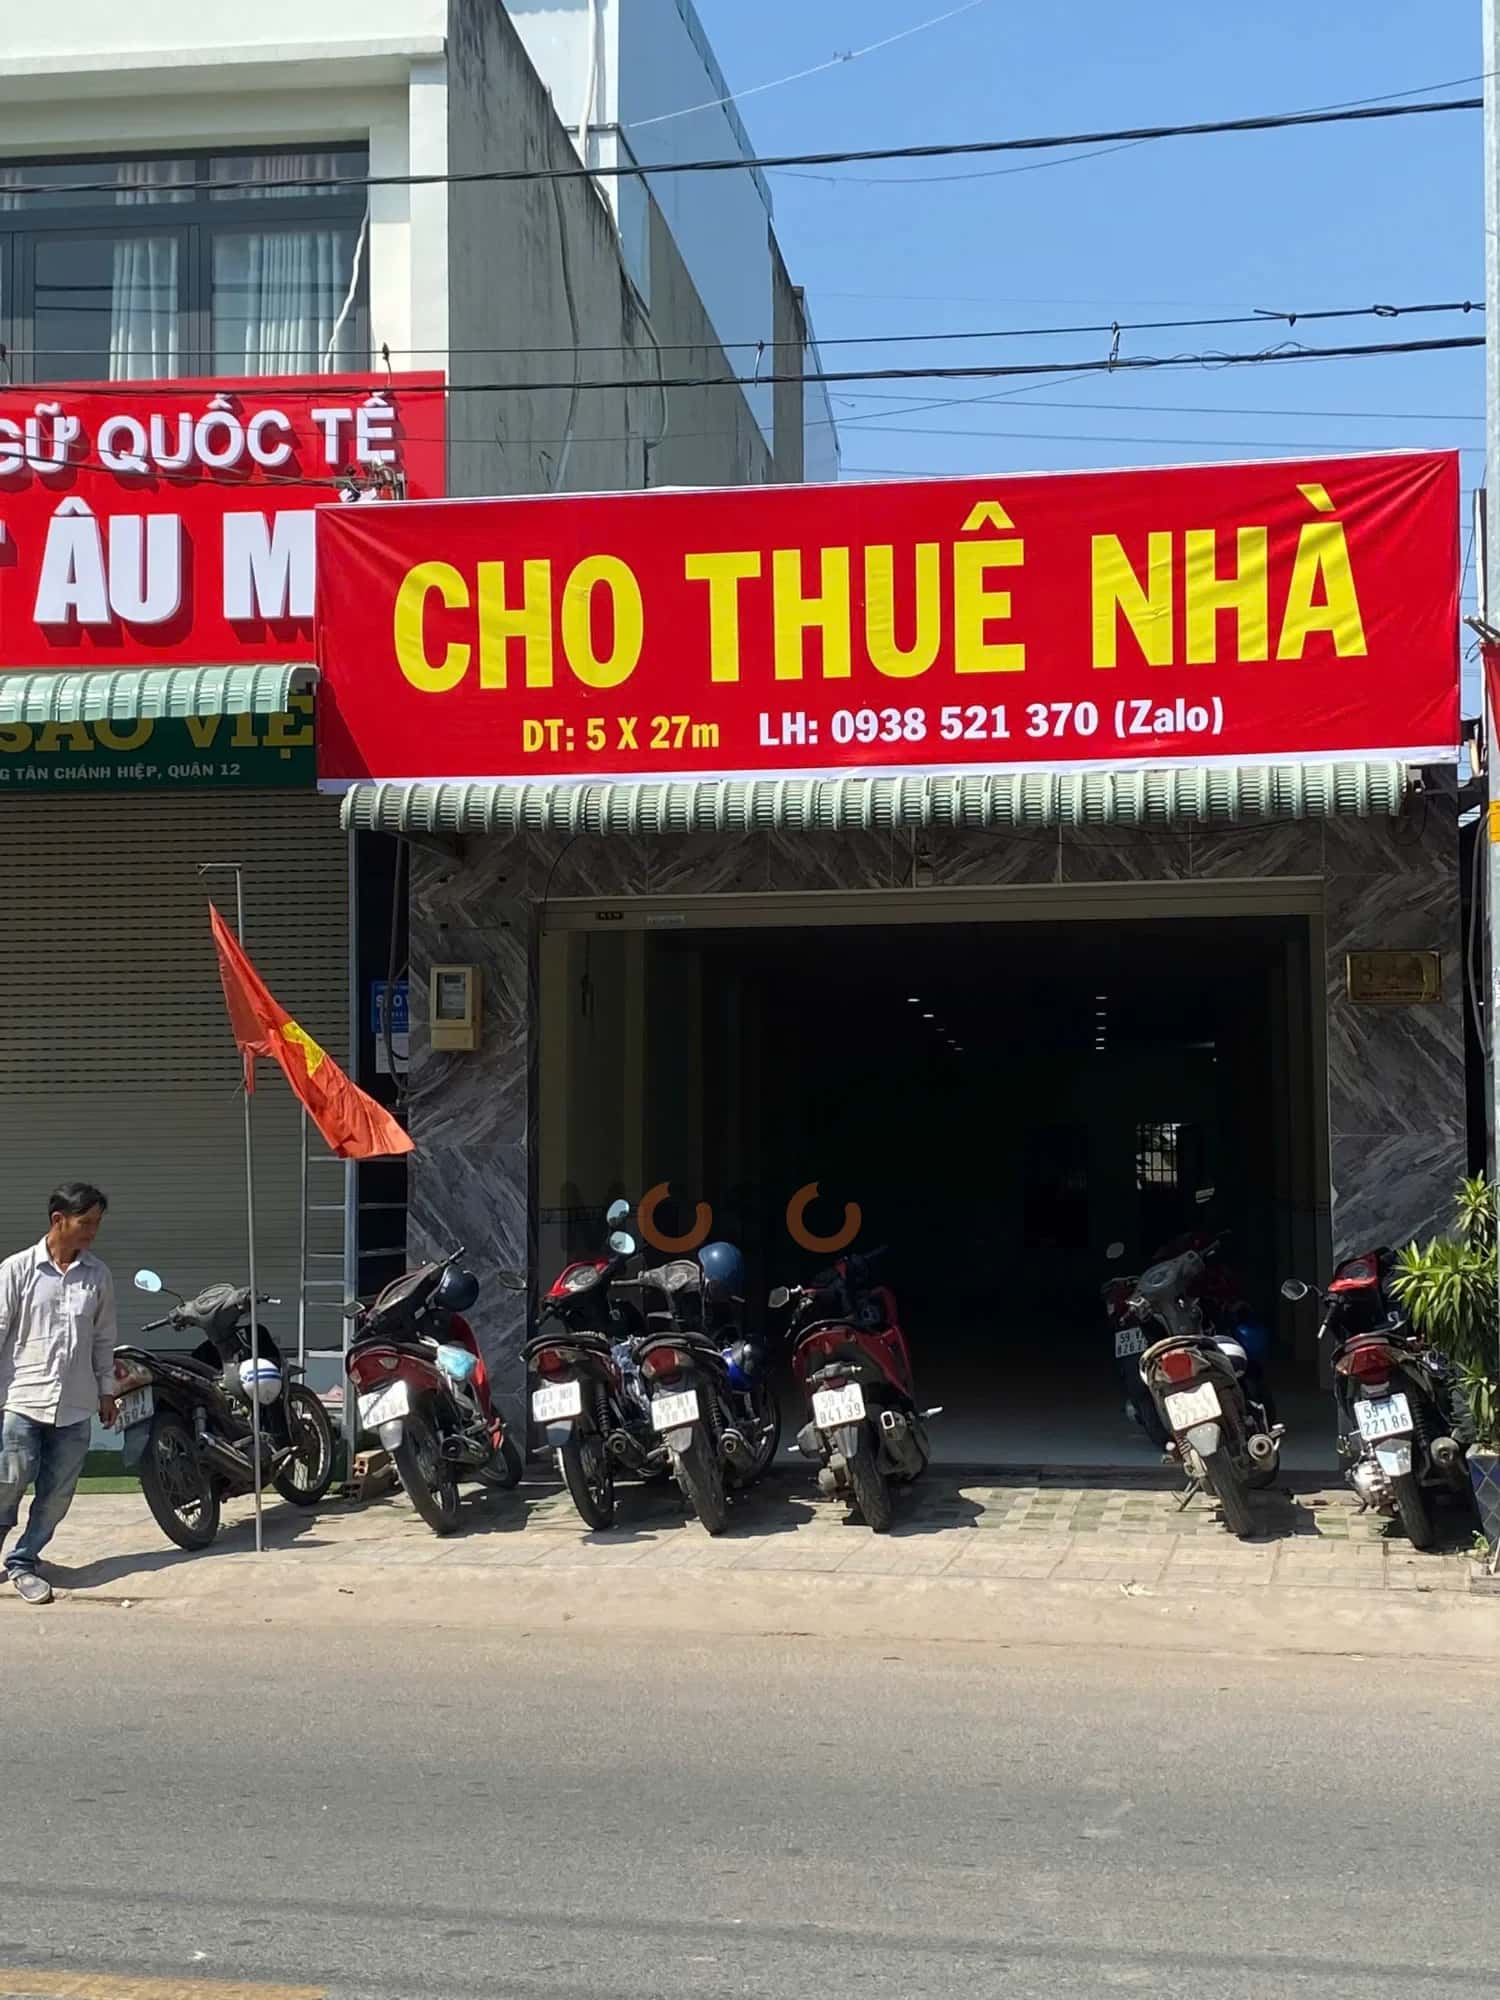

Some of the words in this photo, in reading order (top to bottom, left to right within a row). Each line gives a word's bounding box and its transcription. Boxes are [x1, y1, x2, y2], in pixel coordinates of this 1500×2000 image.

[98, 392, 292, 472] QUỐC
[311, 391, 396, 465] TẾ
[33, 496, 181, 623] ÂU
[394, 554, 644, 693] CHO
[685, 502, 1026, 683] THUÊ
[1092, 484, 1368, 669] NHÀ
[523, 719, 574, 752] DT:
[586, 718, 606, 750] 5
[617, 717, 639, 749] X
[650, 715, 719, 748] 27m
[759, 712, 818, 746] LH:
[831, 707, 927, 743] 0938
[940, 705, 1010, 740] 521
[1026, 702, 1098, 737] 370
[1115, 697, 1224, 738] (Zalo)
[15, 765, 49, 780] TÂN
[54, 763, 111, 780] CHÁNH
[168, 762, 214, 778] QUẬN
[220, 763, 241, 777] 12
